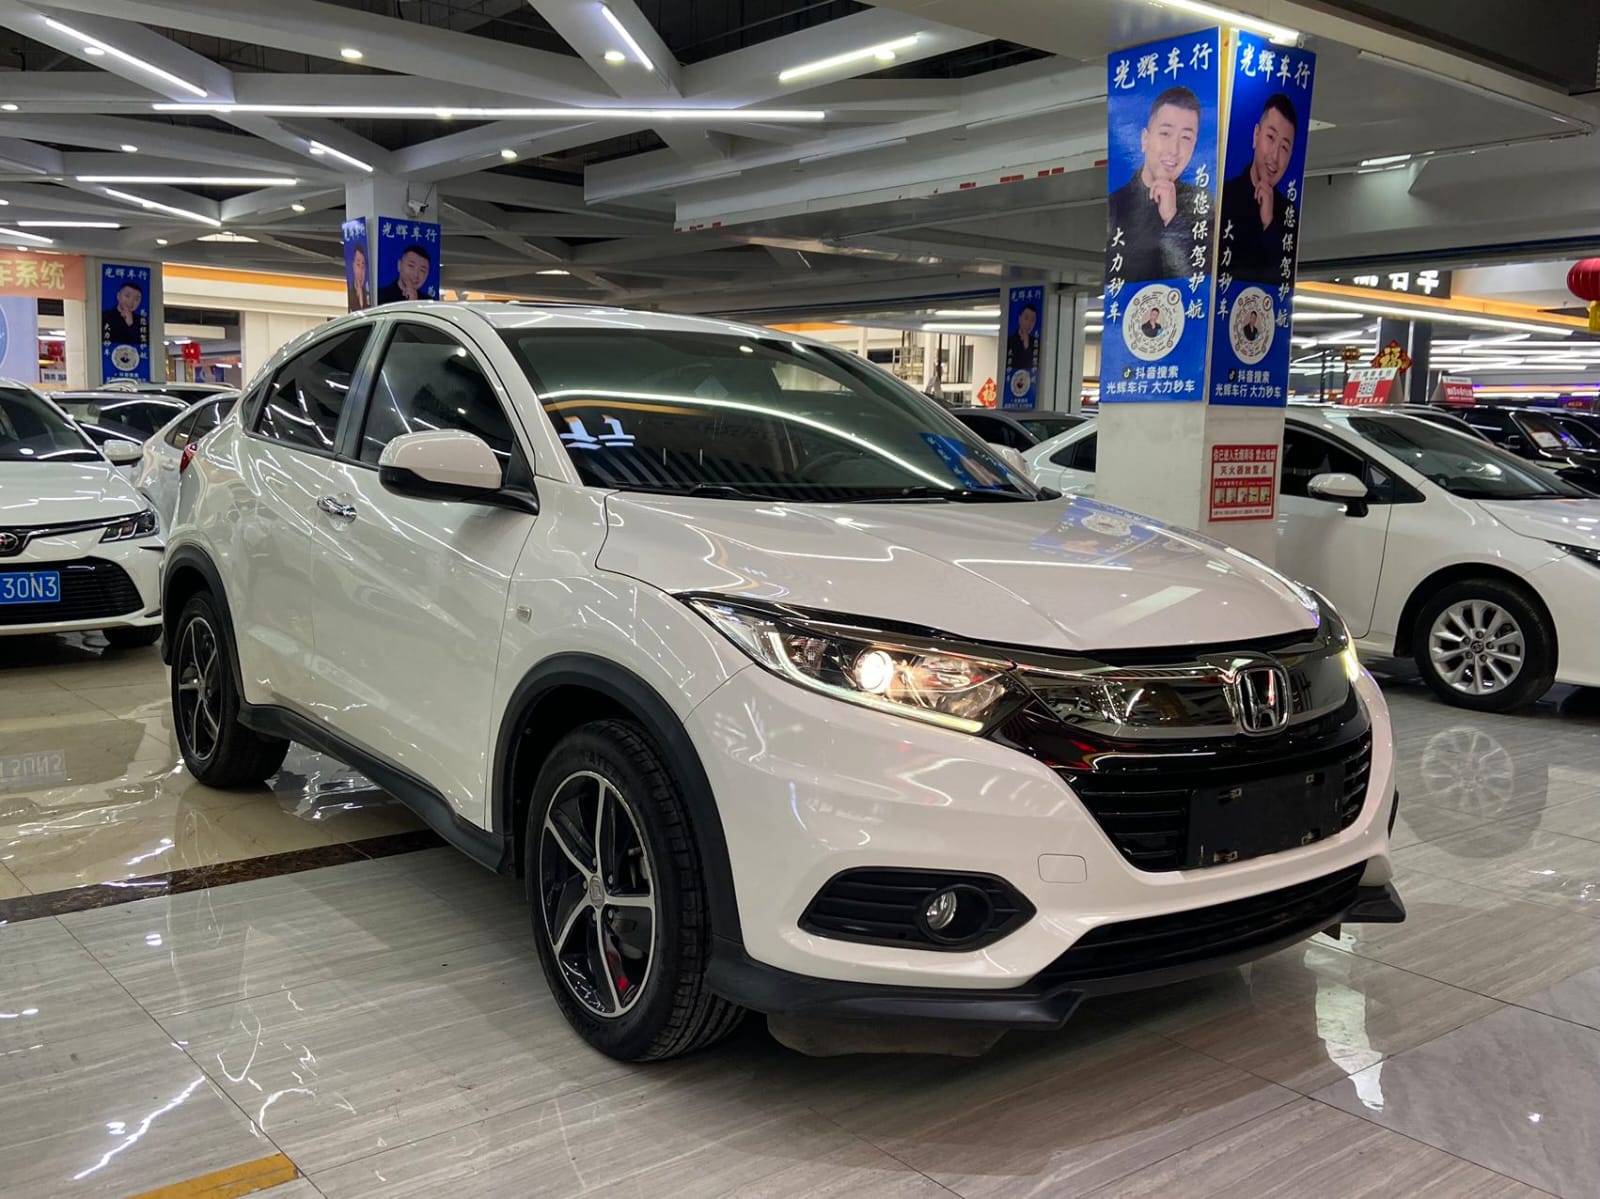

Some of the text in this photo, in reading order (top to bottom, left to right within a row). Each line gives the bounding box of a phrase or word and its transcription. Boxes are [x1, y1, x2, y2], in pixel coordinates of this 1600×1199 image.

[1113, 41, 1213, 90] 光辉车行
[1239, 44, 1311, 90] 光辉车行
[382, 222, 438, 243] 光辉车行
[1185, 163, 1210, 321] 为您保驾护航
[1275, 178, 1298, 329] 为您保驾护航
[1107, 227, 1126, 325] 大力秒车
[1217, 219, 1235, 321] 大力秒车
[1106, 380, 1196, 395] 光辉车行 大力秒车
[1135, 365, 1180, 381] 抖音搜索
[1249, 384, 1283, 400] 大力秒车
[2, 576, 58, 599] 30N3
